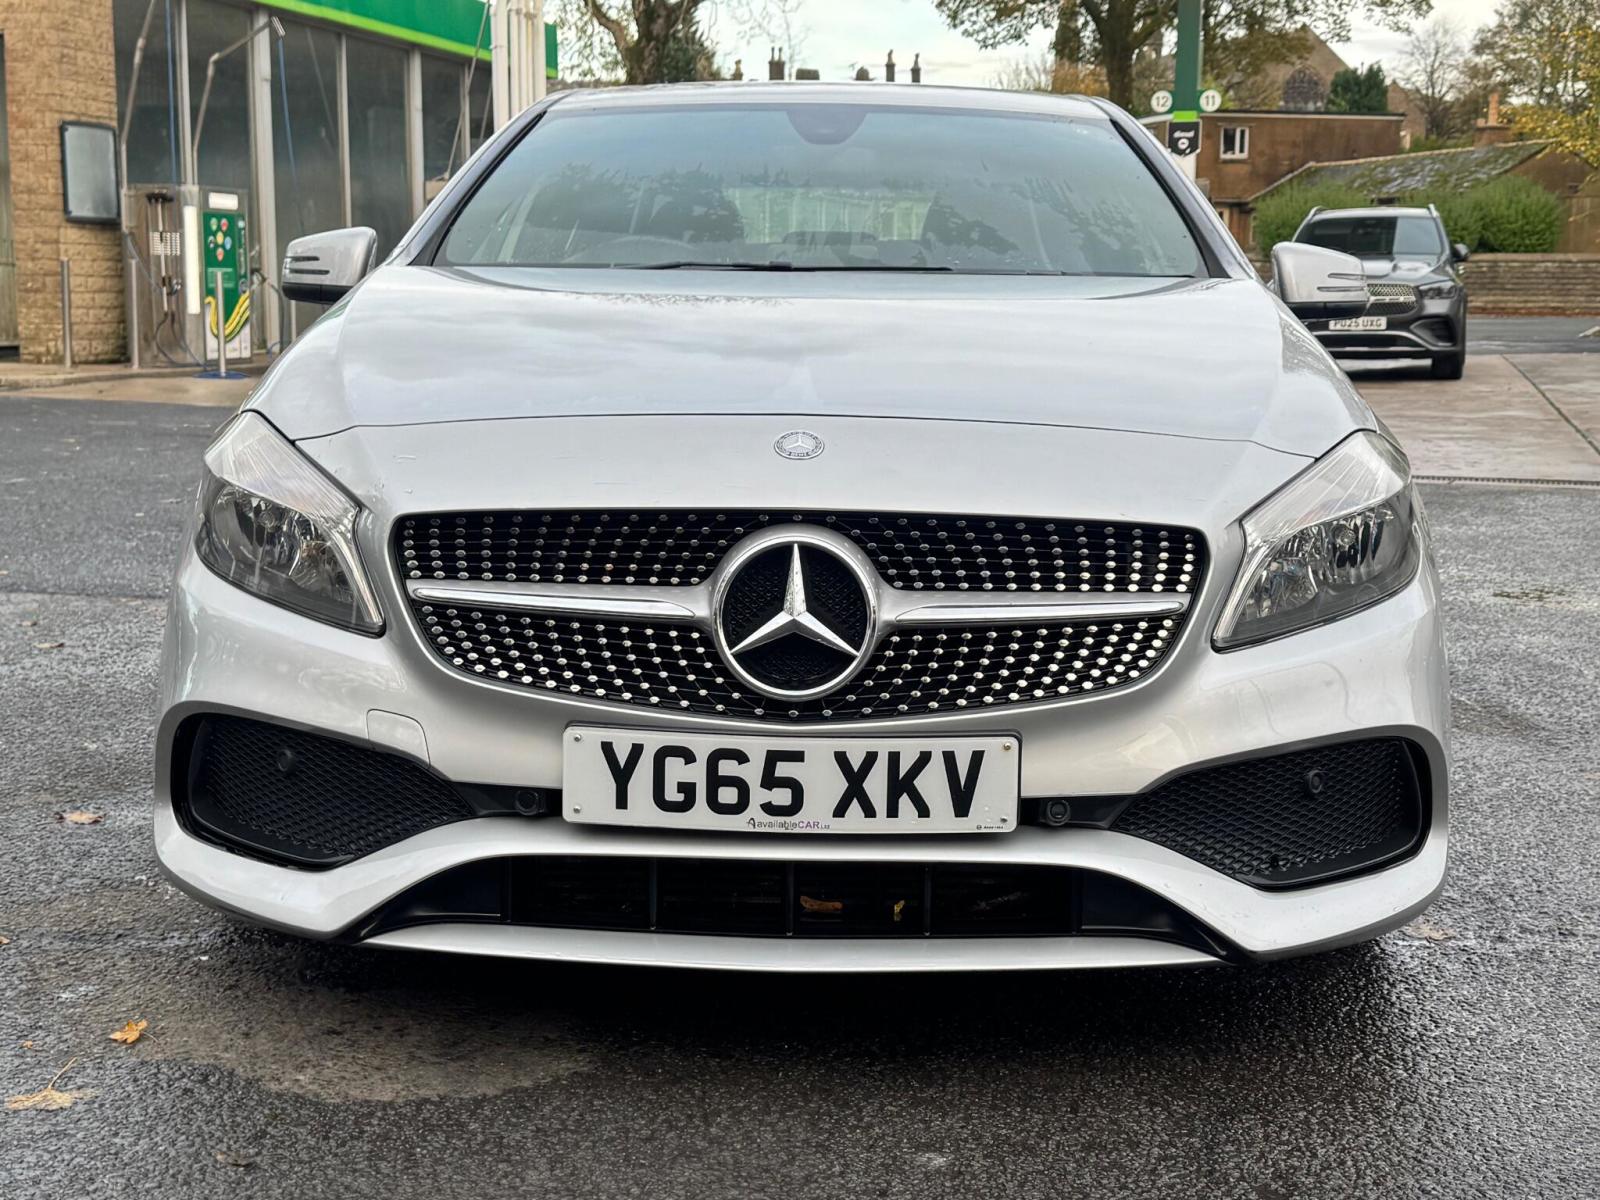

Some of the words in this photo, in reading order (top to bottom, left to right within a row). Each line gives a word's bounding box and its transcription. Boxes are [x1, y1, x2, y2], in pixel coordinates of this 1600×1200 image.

[1155, 95, 1169, 108] 12
[1204, 94, 1216, 107] 11
[600, 740, 805, 817] YG65
[832, 749, 986, 819] XKV
